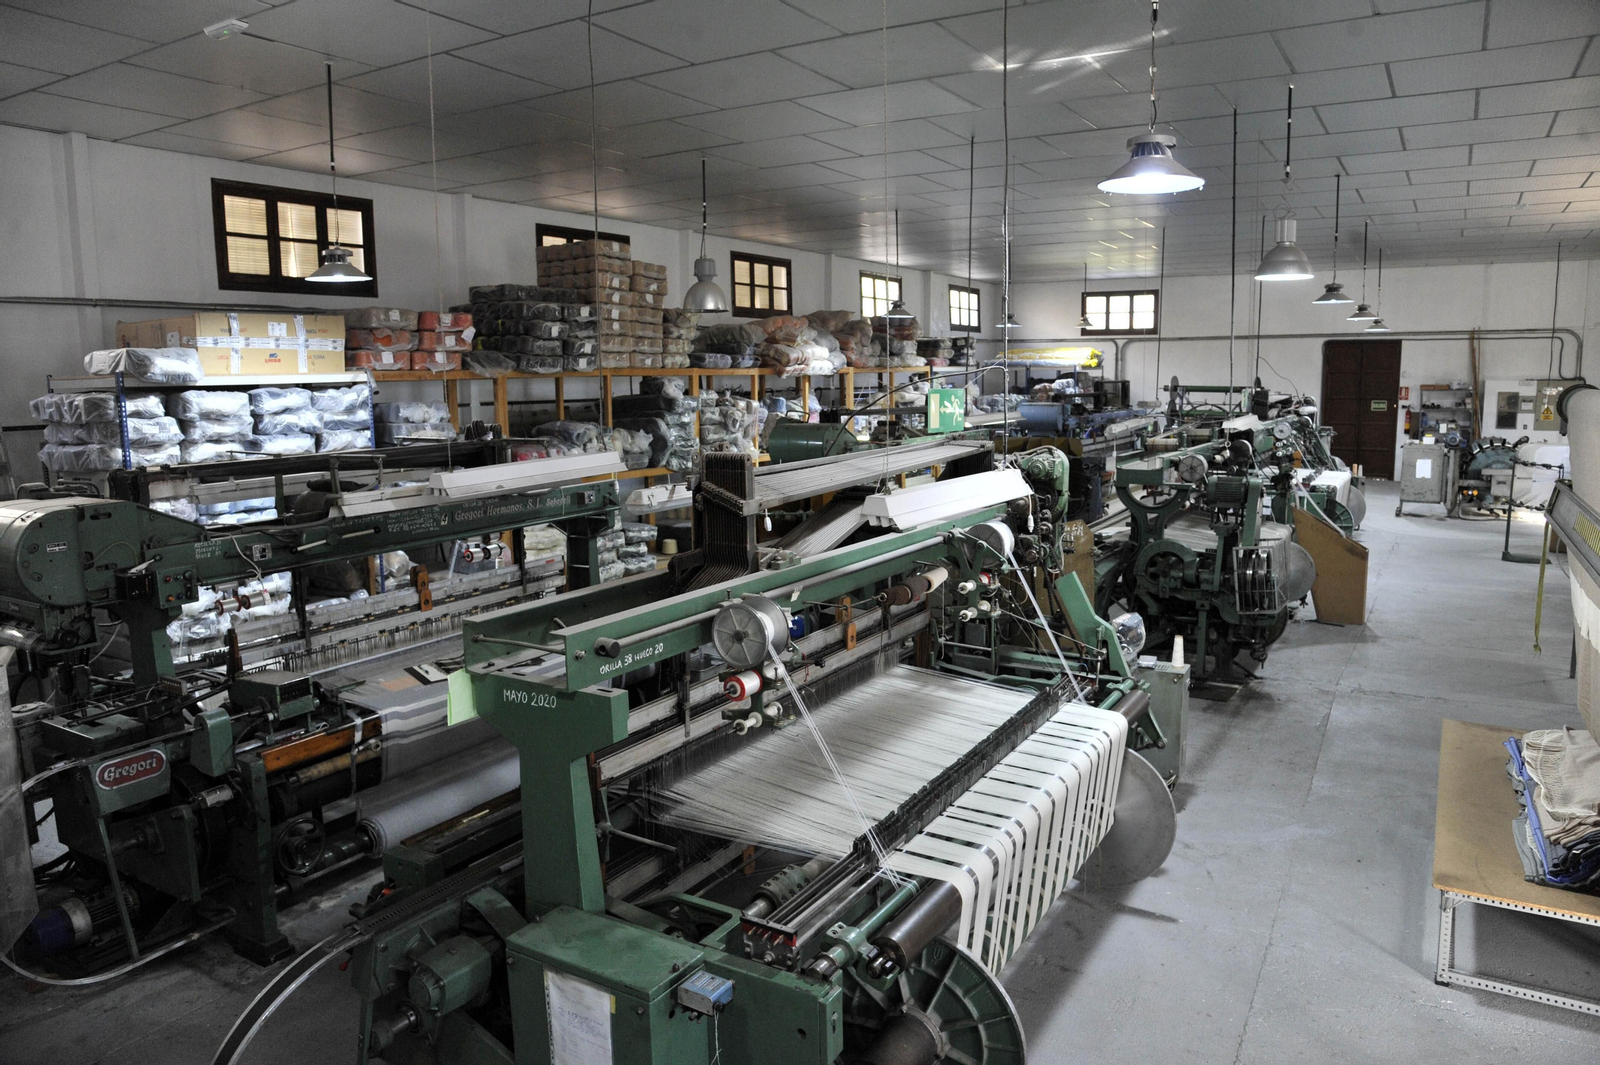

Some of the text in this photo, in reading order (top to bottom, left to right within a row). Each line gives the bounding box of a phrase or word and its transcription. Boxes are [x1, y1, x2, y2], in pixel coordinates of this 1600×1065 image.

[454, 510, 485, 522] Gregori
[487, 502, 524, 516] Hermanos,
[599, 642, 664, 675] ORILLA 38 HUECO 20
[503, 688, 557, 709] MAYO 2020
[103, 755, 157, 782] Gregori
